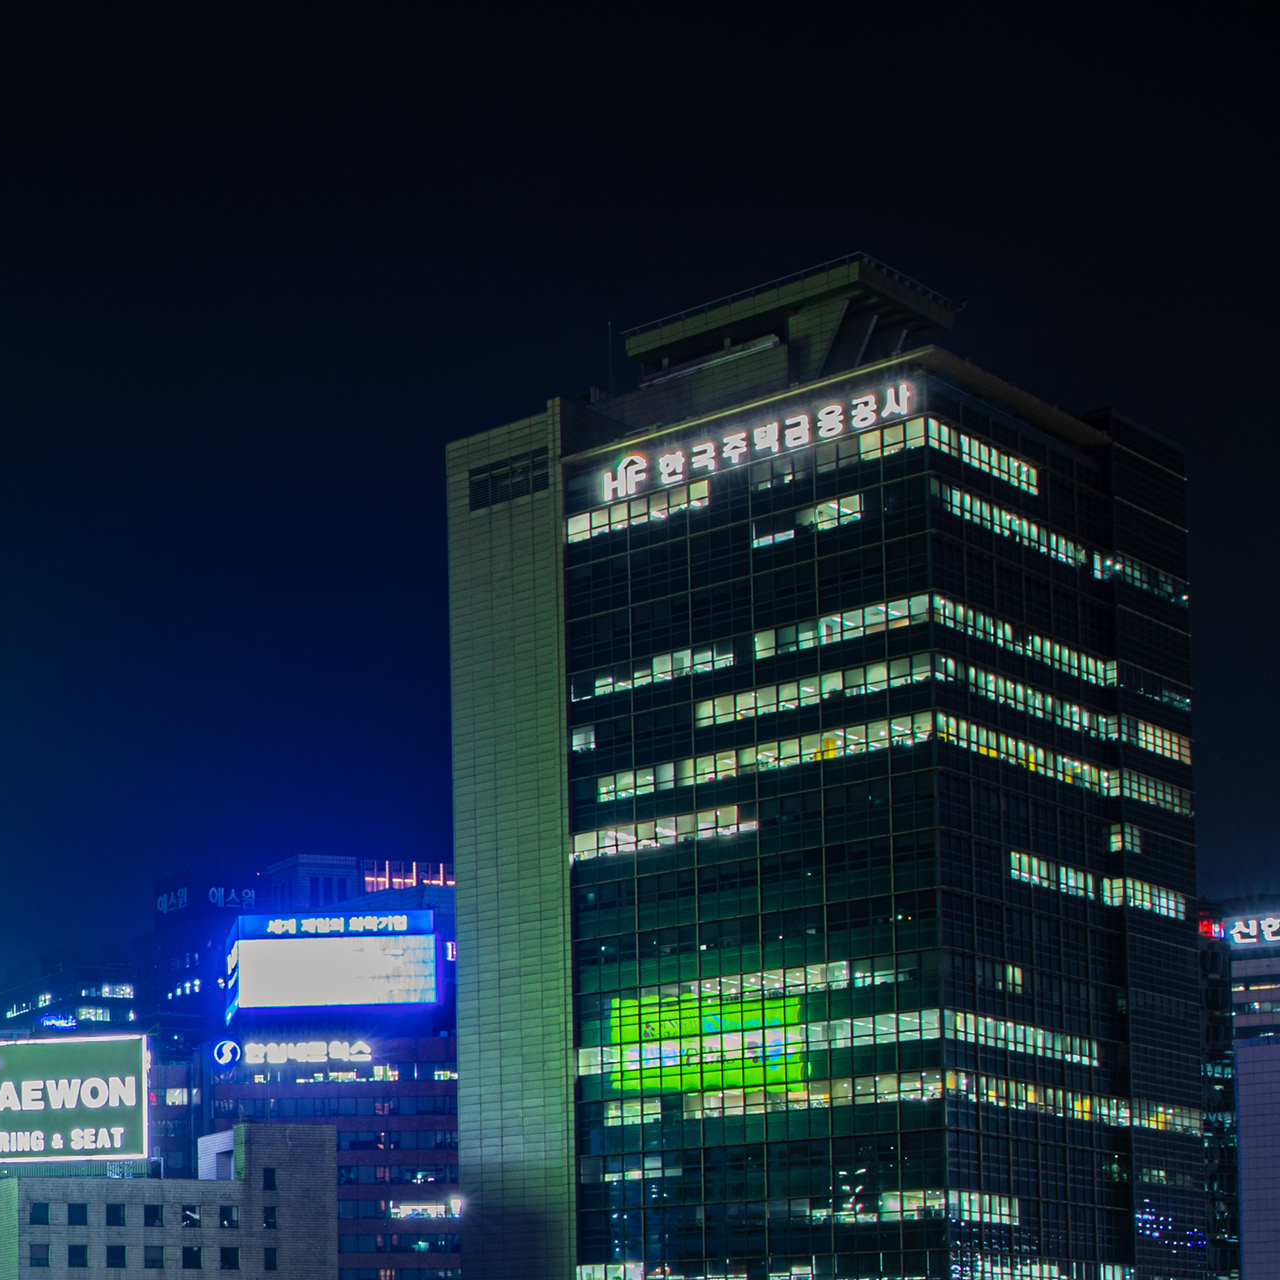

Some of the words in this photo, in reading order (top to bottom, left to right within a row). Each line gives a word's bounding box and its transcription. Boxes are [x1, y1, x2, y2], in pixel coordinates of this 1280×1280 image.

[658, 384, 910, 484] 한국주택금융공사
[603, 458, 647, 501] HF
[157, 887, 188, 914] 에스원
[208, 886, 256, 909] 에스원
[51, 1132, 65, 1150] &
[70, 1126, 125, 1150] SEAT
